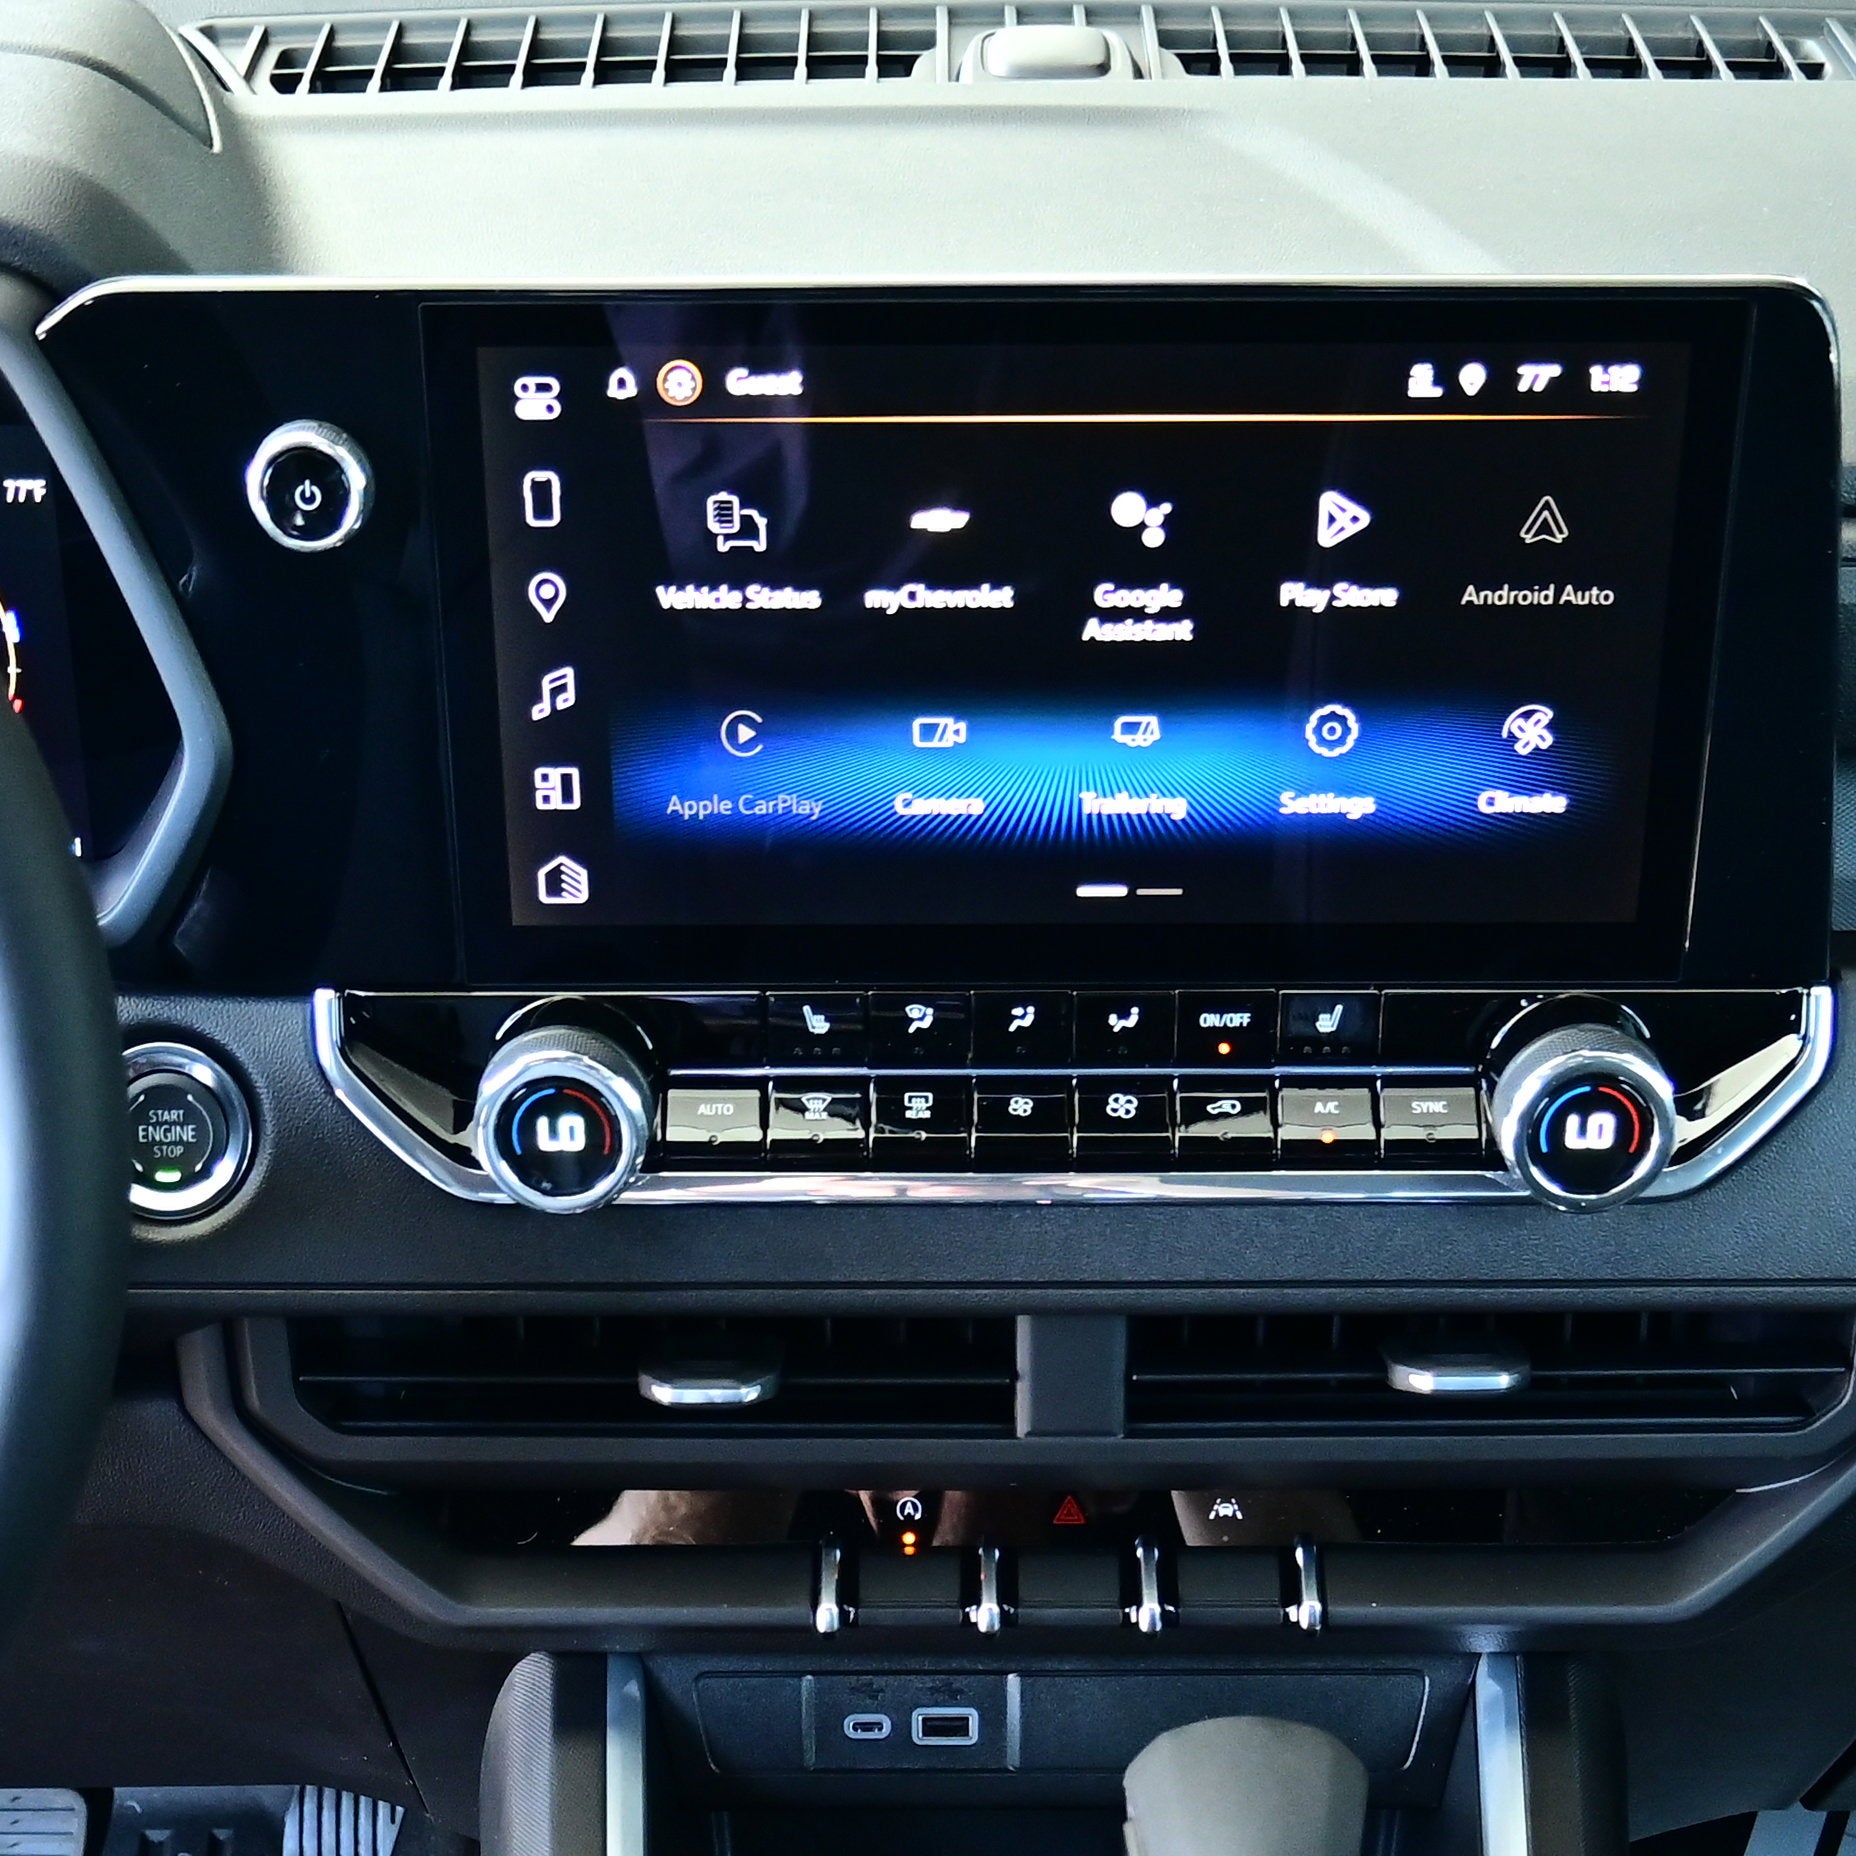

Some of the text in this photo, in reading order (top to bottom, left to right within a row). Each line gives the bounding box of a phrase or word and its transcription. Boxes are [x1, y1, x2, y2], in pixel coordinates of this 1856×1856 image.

[656, 584, 822, 610] Vehicle Status
[864, 583, 1014, 614] myChevrolet
[1094, 583, 1184, 614] Google
[1279, 582, 1399, 613] Play Store
[1461, 583, 1614, 607] Android Auto
[1081, 617, 1194, 641] Assistant
[666, 794, 824, 820] Apple CarPlay
[894, 793, 985, 816] Camera
[1079, 791, 1187, 820] Trailering
[1279, 791, 1376, 819] Settings
[1477, 791, 1569, 815] Climate
[1199, 1013, 1251, 1028] ON/OFF
[149, 1109, 185, 1123] START
[697, 1104, 734, 1116] AUTO
[905, 1111, 931, 1119] REAR
[1314, 1101, 1340, 1115] A/C
[1411, 1101, 1449, 1114] SYNC
[138, 1124, 197, 1143] ENGINE
[153, 1146, 185, 1158] STOP
